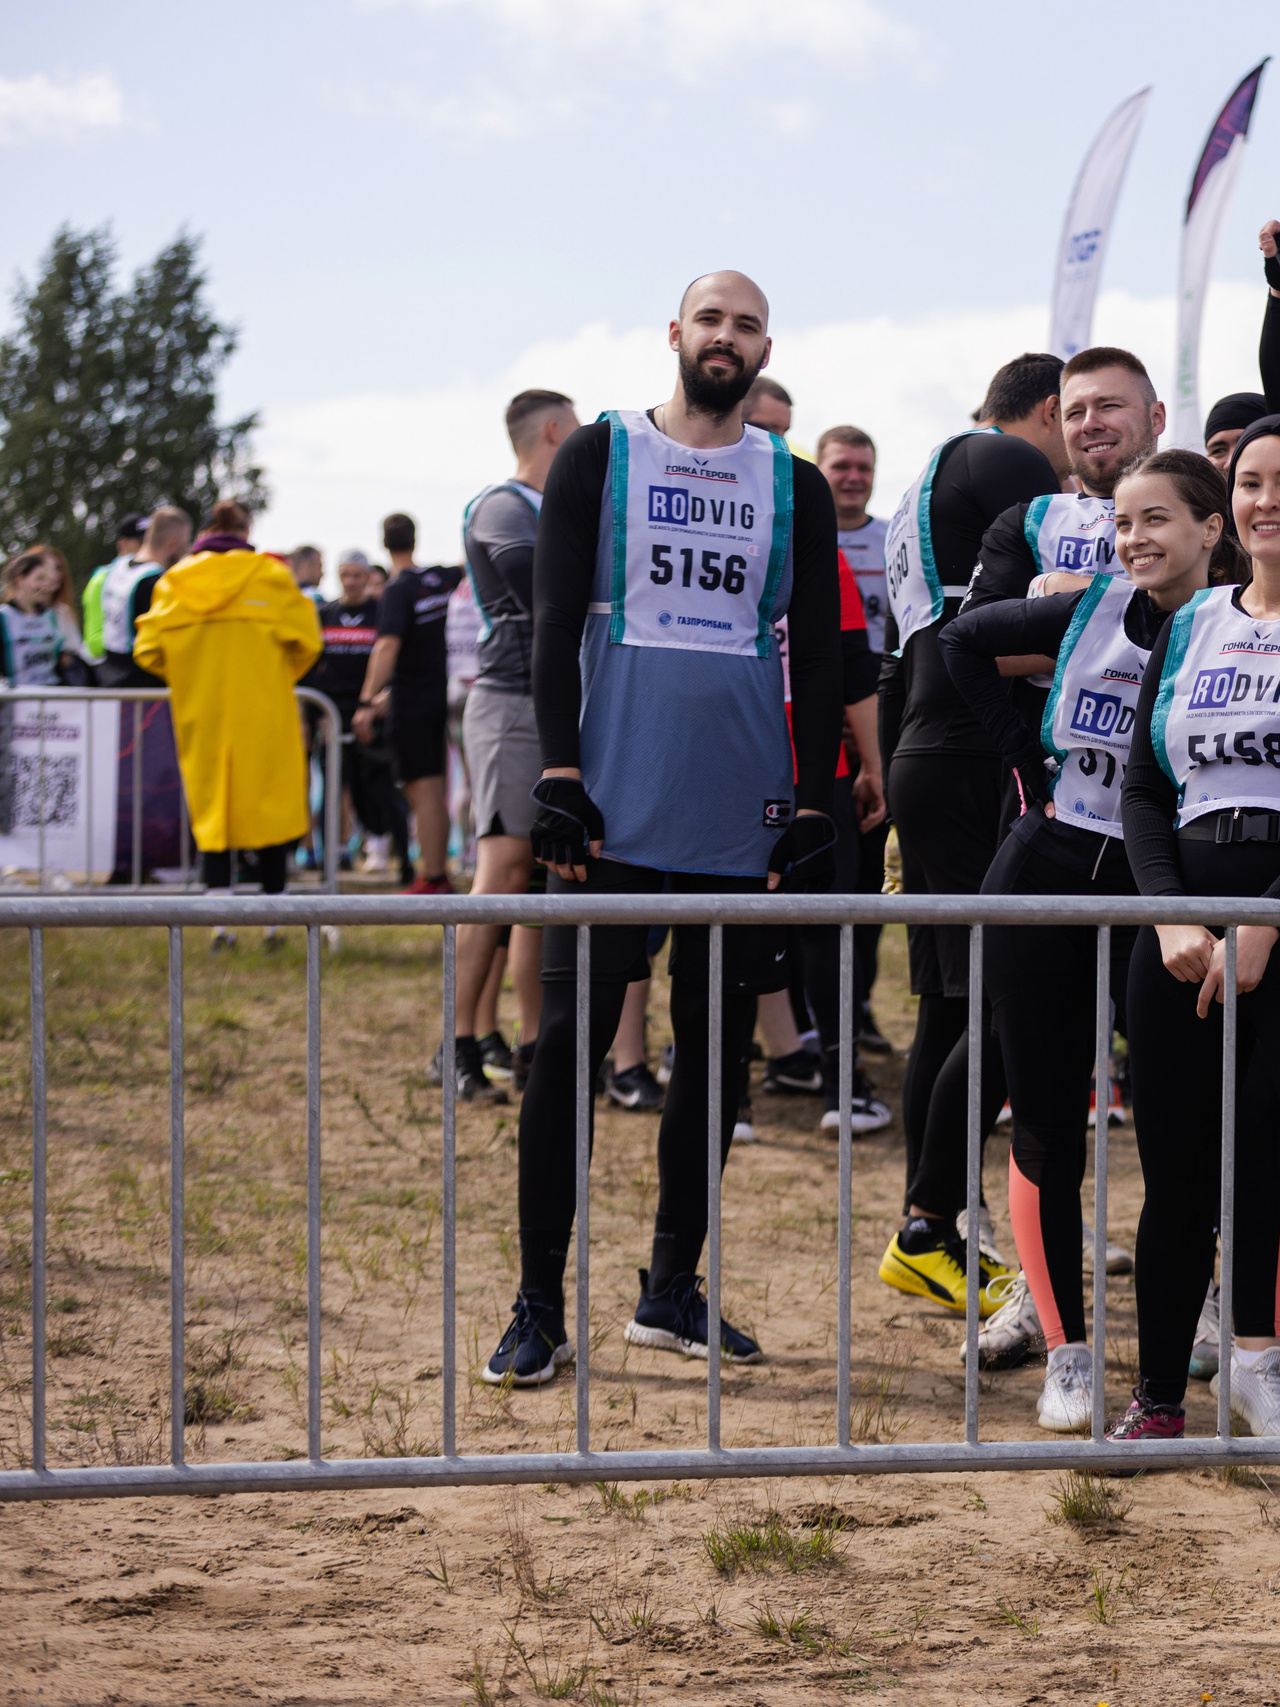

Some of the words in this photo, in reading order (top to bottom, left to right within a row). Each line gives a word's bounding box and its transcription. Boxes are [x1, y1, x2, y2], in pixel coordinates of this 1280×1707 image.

[665, 465, 697, 475] ГОНКА
[700, 469, 737, 481] ГЕРОЕВ
[652, 490, 754, 530] RODVIG
[649, 544, 748, 595] 5156
[677, 616, 733, 631] ГАЗПРОМБАНК
[1222, 642, 1254, 651] ГОНКА
[1104, 668, 1138, 681] ГОНКА
[1076, 696, 1137, 735] ROD
